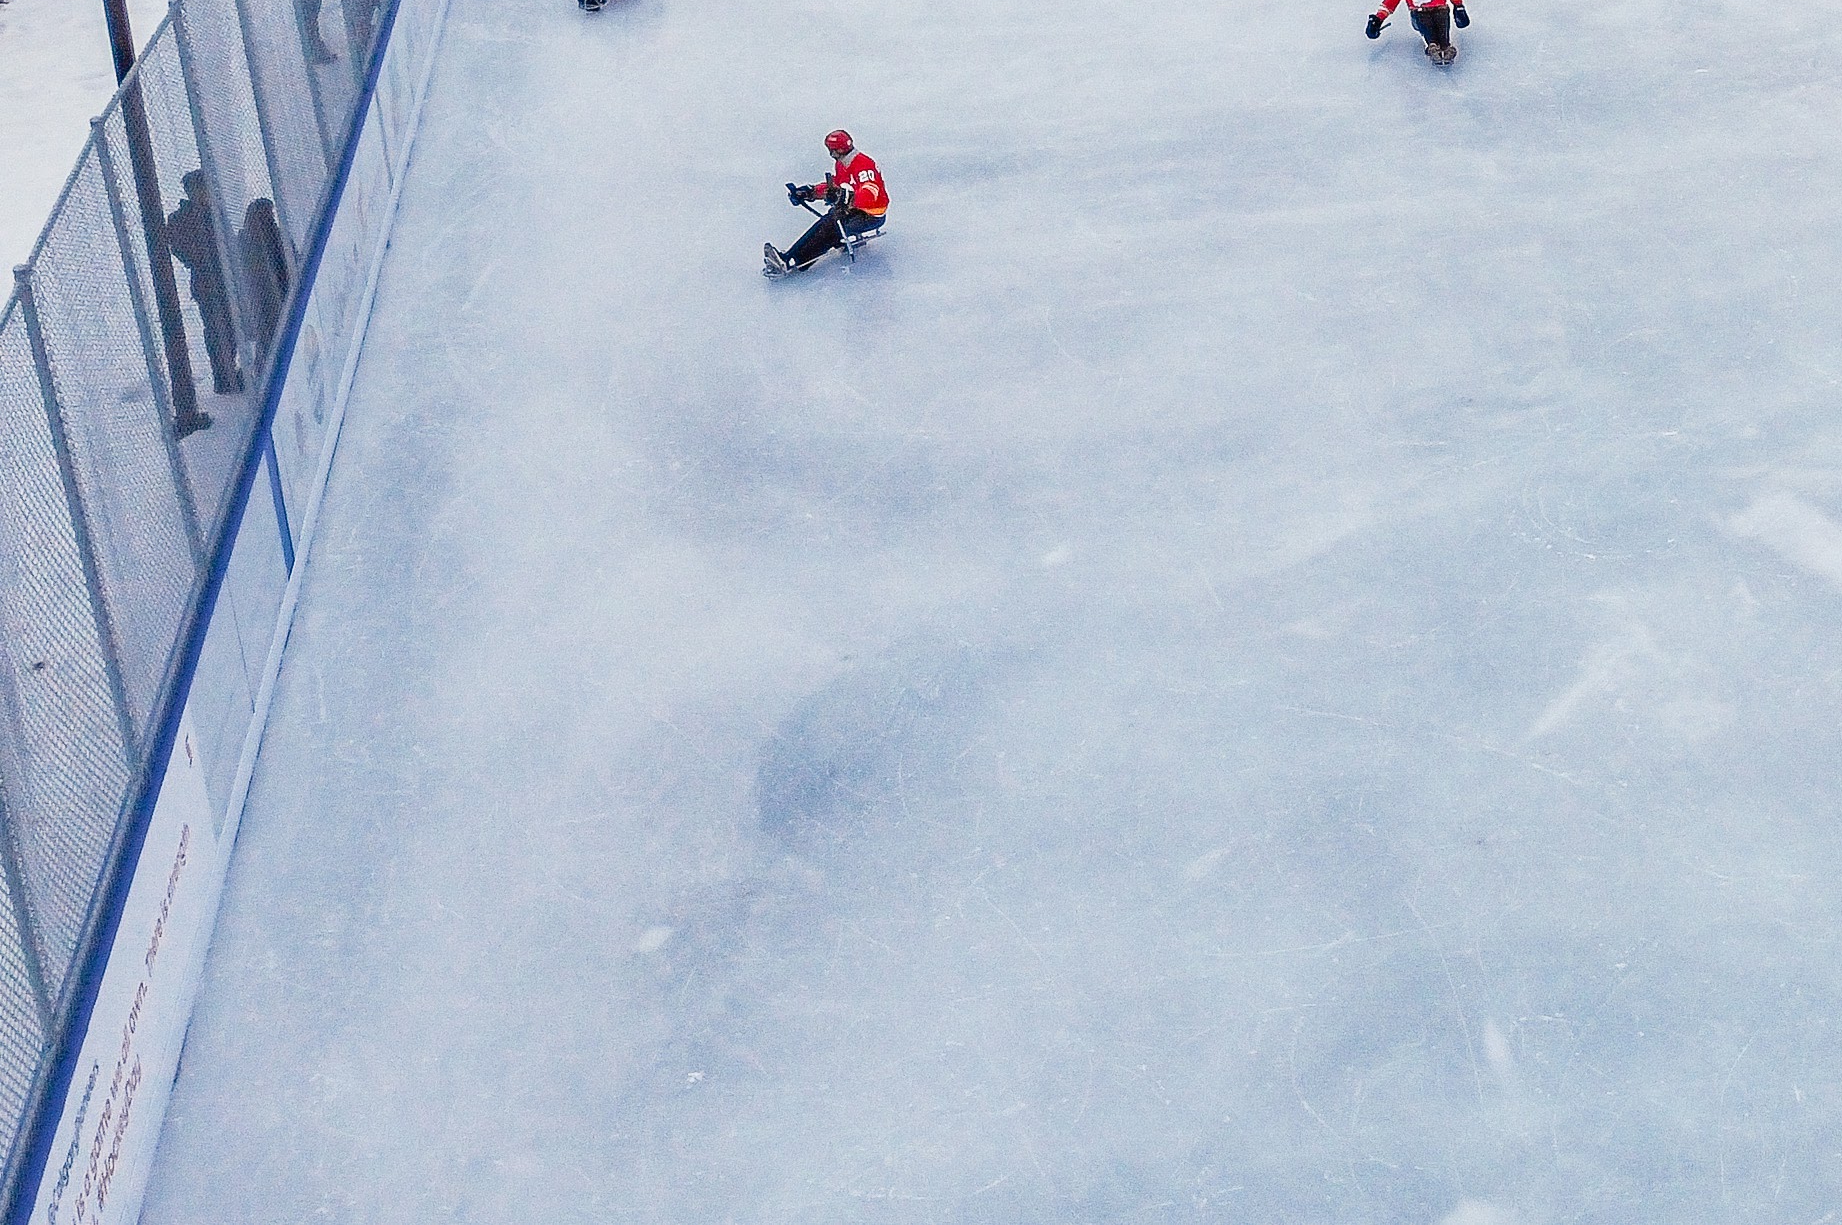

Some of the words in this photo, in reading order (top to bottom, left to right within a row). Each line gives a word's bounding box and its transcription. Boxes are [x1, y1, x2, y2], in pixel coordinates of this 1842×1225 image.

[858, 169, 875, 183] 20
[90, 1098, 111, 1181] game
[97, 1054, 141, 1213] #HockeyDay
